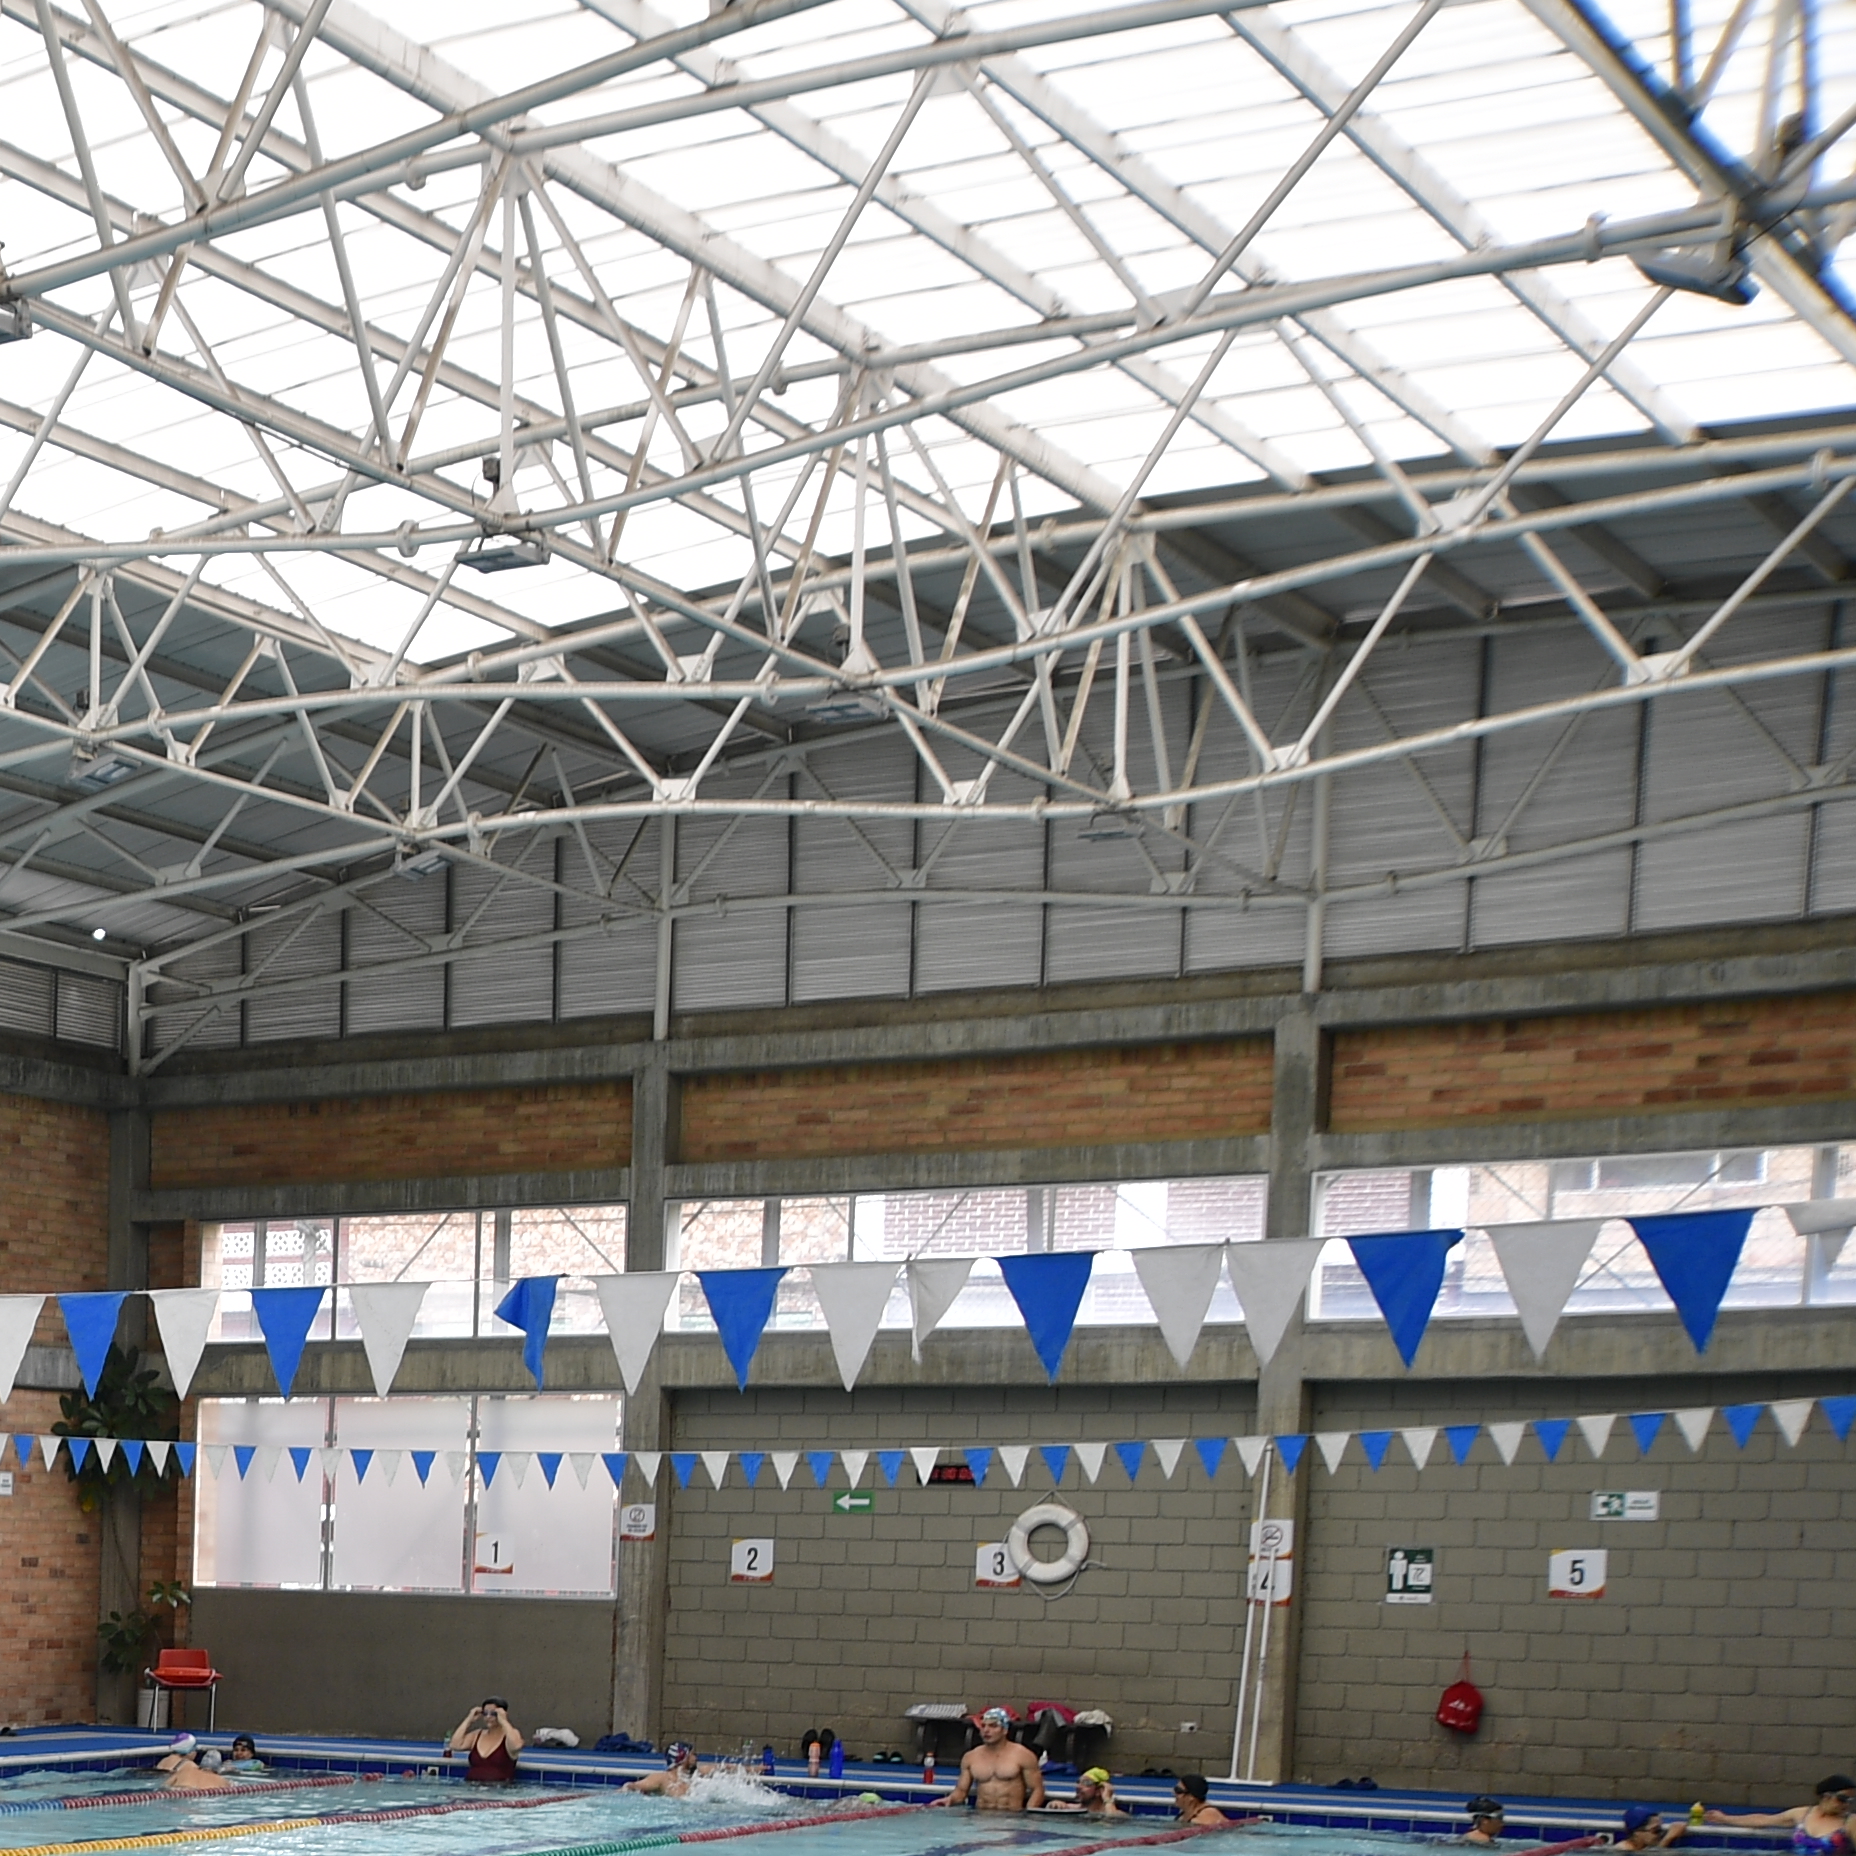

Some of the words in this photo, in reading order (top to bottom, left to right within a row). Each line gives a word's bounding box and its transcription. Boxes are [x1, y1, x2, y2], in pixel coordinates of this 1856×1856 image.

[491, 1540, 499, 1564] 1
[746, 1547, 758, 1571] 2
[992, 1551, 1005, 1576] 3
[1569, 1558, 1585, 1586] 5
